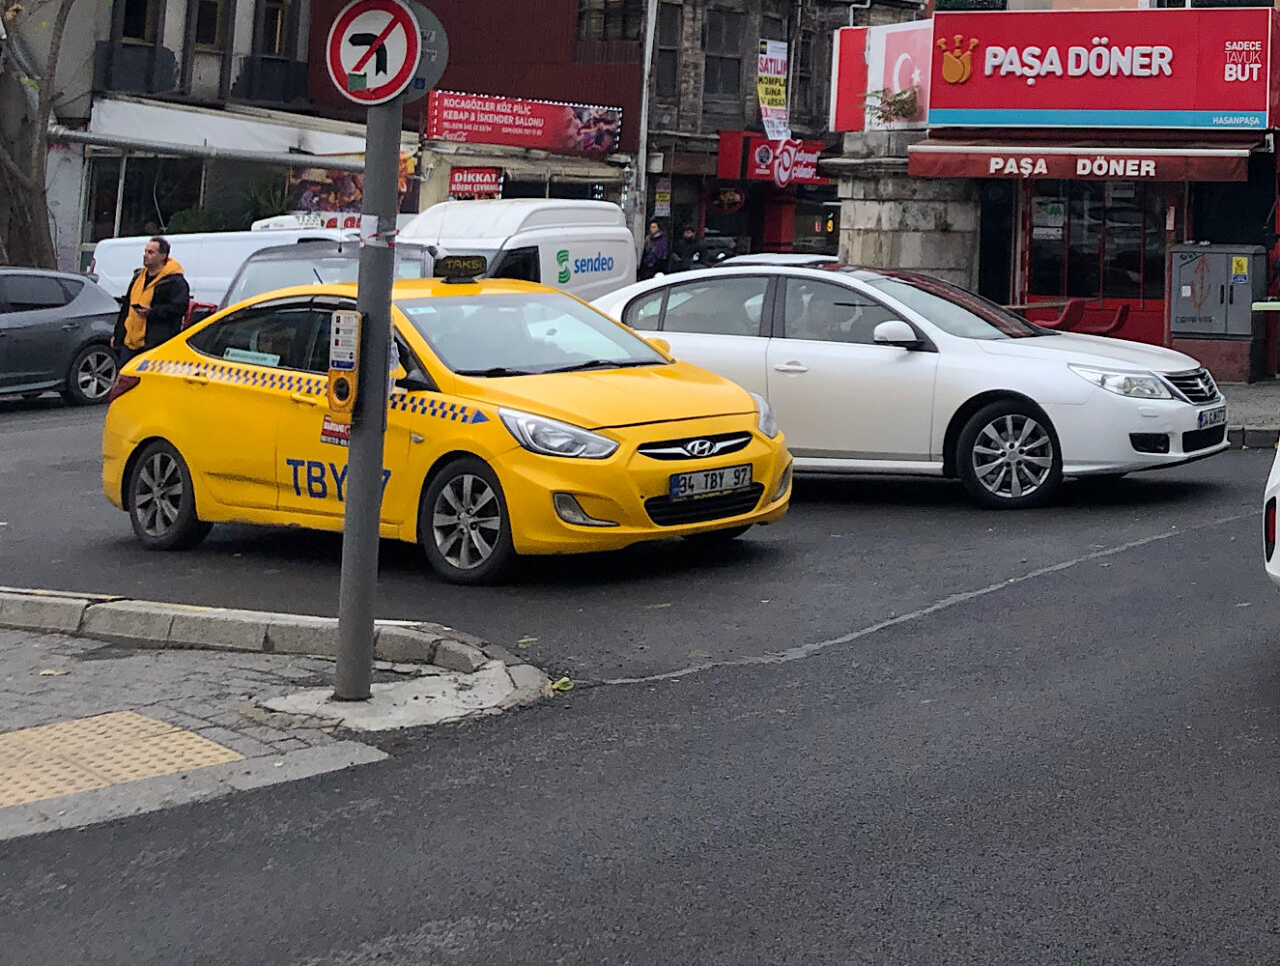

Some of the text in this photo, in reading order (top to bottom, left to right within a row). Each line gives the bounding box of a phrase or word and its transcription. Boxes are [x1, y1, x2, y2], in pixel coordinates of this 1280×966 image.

[1224, 40, 1262, 51] SADECE
[984, 36, 1173, 86] PAŞA DÖNER
[1224, 51, 1262, 64] TAVUK
[1224, 63, 1262, 82] BUT
[496, 101, 512, 113] KÖZ
[442, 110, 470, 121] KEBAP
[477, 111, 514, 125] İSKENDER
[515, 116, 544, 127] SALONU
[1212, 116, 1260, 126] HASANPAŞA
[989, 156, 1156, 178] PAŞA DÖNER
[454, 170, 497, 183] DİKKAT
[573, 252, 614, 274] sendeo
[286, 458, 349, 502] TBY
[679, 467, 748, 494] 34 TBY 97
